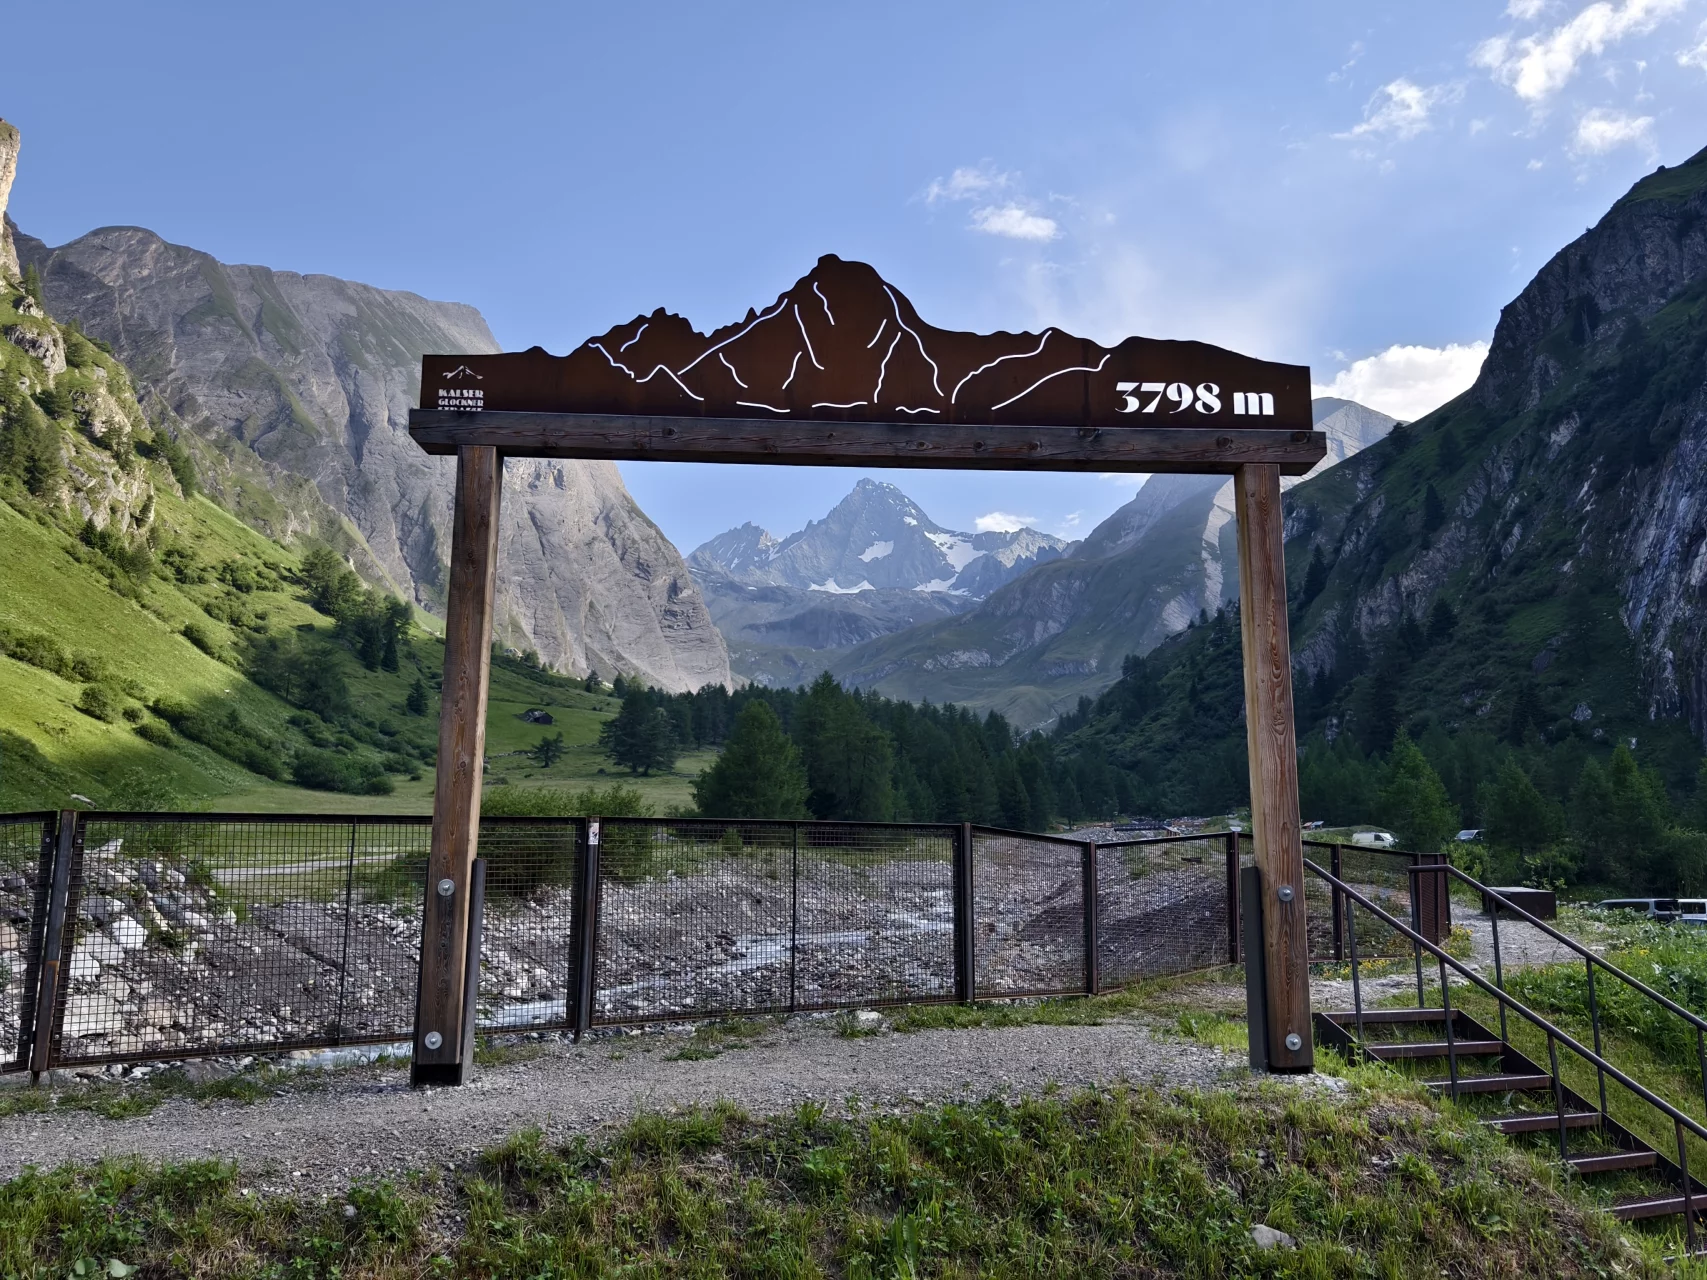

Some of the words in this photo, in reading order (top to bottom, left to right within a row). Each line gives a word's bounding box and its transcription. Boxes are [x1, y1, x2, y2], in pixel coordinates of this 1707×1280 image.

[438, 388, 484, 398] KALSER
[438, 398, 484, 407] GLOCKNER
[1114, 381, 1222, 415] 3798
[1233, 391, 1275, 416] m
